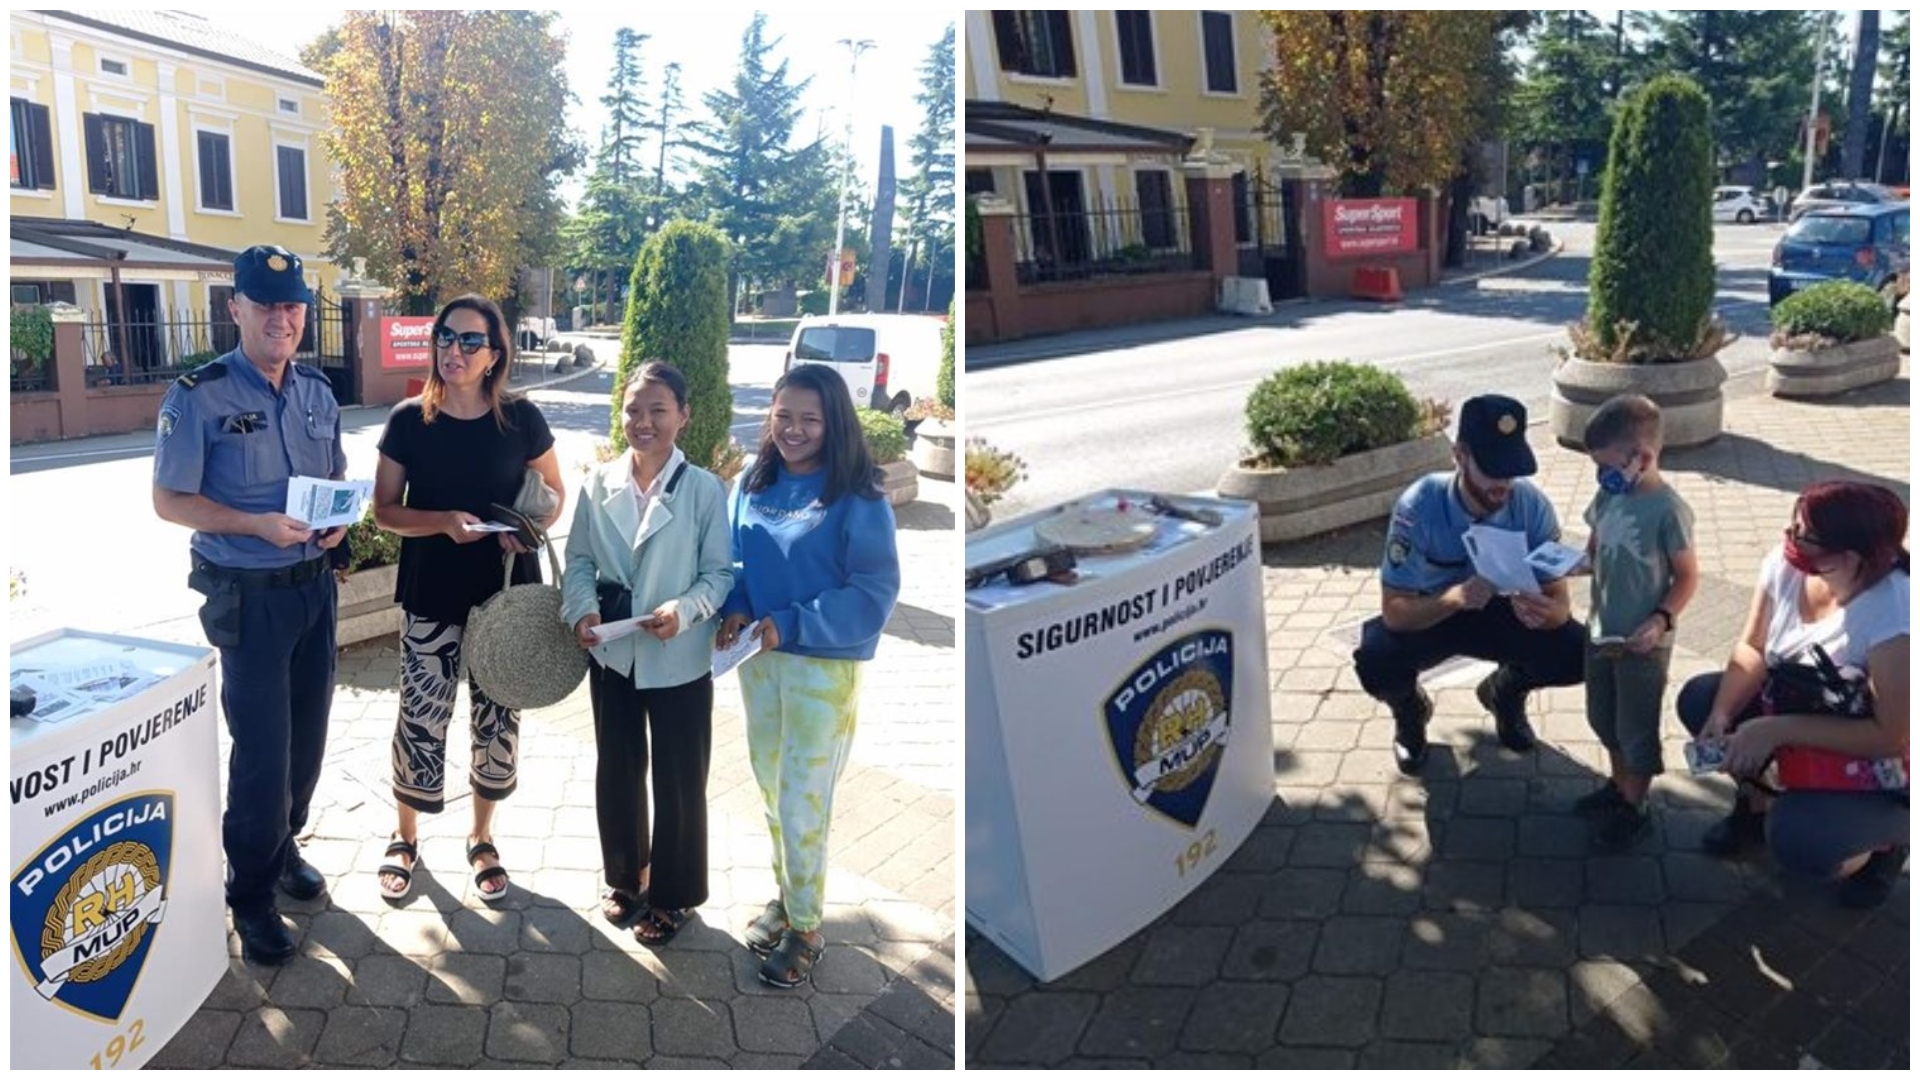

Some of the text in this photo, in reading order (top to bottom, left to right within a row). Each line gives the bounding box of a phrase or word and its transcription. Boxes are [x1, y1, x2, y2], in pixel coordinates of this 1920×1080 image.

[1334, 204, 1402, 224] SuperSport
[1017, 534, 1254, 659] SIGURNOST I POVJERENJE
[1114, 636, 1228, 712] POLICIJA
[82, 749, 91, 775] I
[99, 684, 207, 767] POVJERENJE
[1160, 729, 1212, 775] MUP
[44, 760, 142, 817] www.policija.hr
[17, 802, 166, 897] POLICIJA
[1175, 828, 1218, 878] 192
[73, 871, 135, 937] RH
[73, 908, 140, 963] MUP
[90, 1019, 146, 1070] 192
